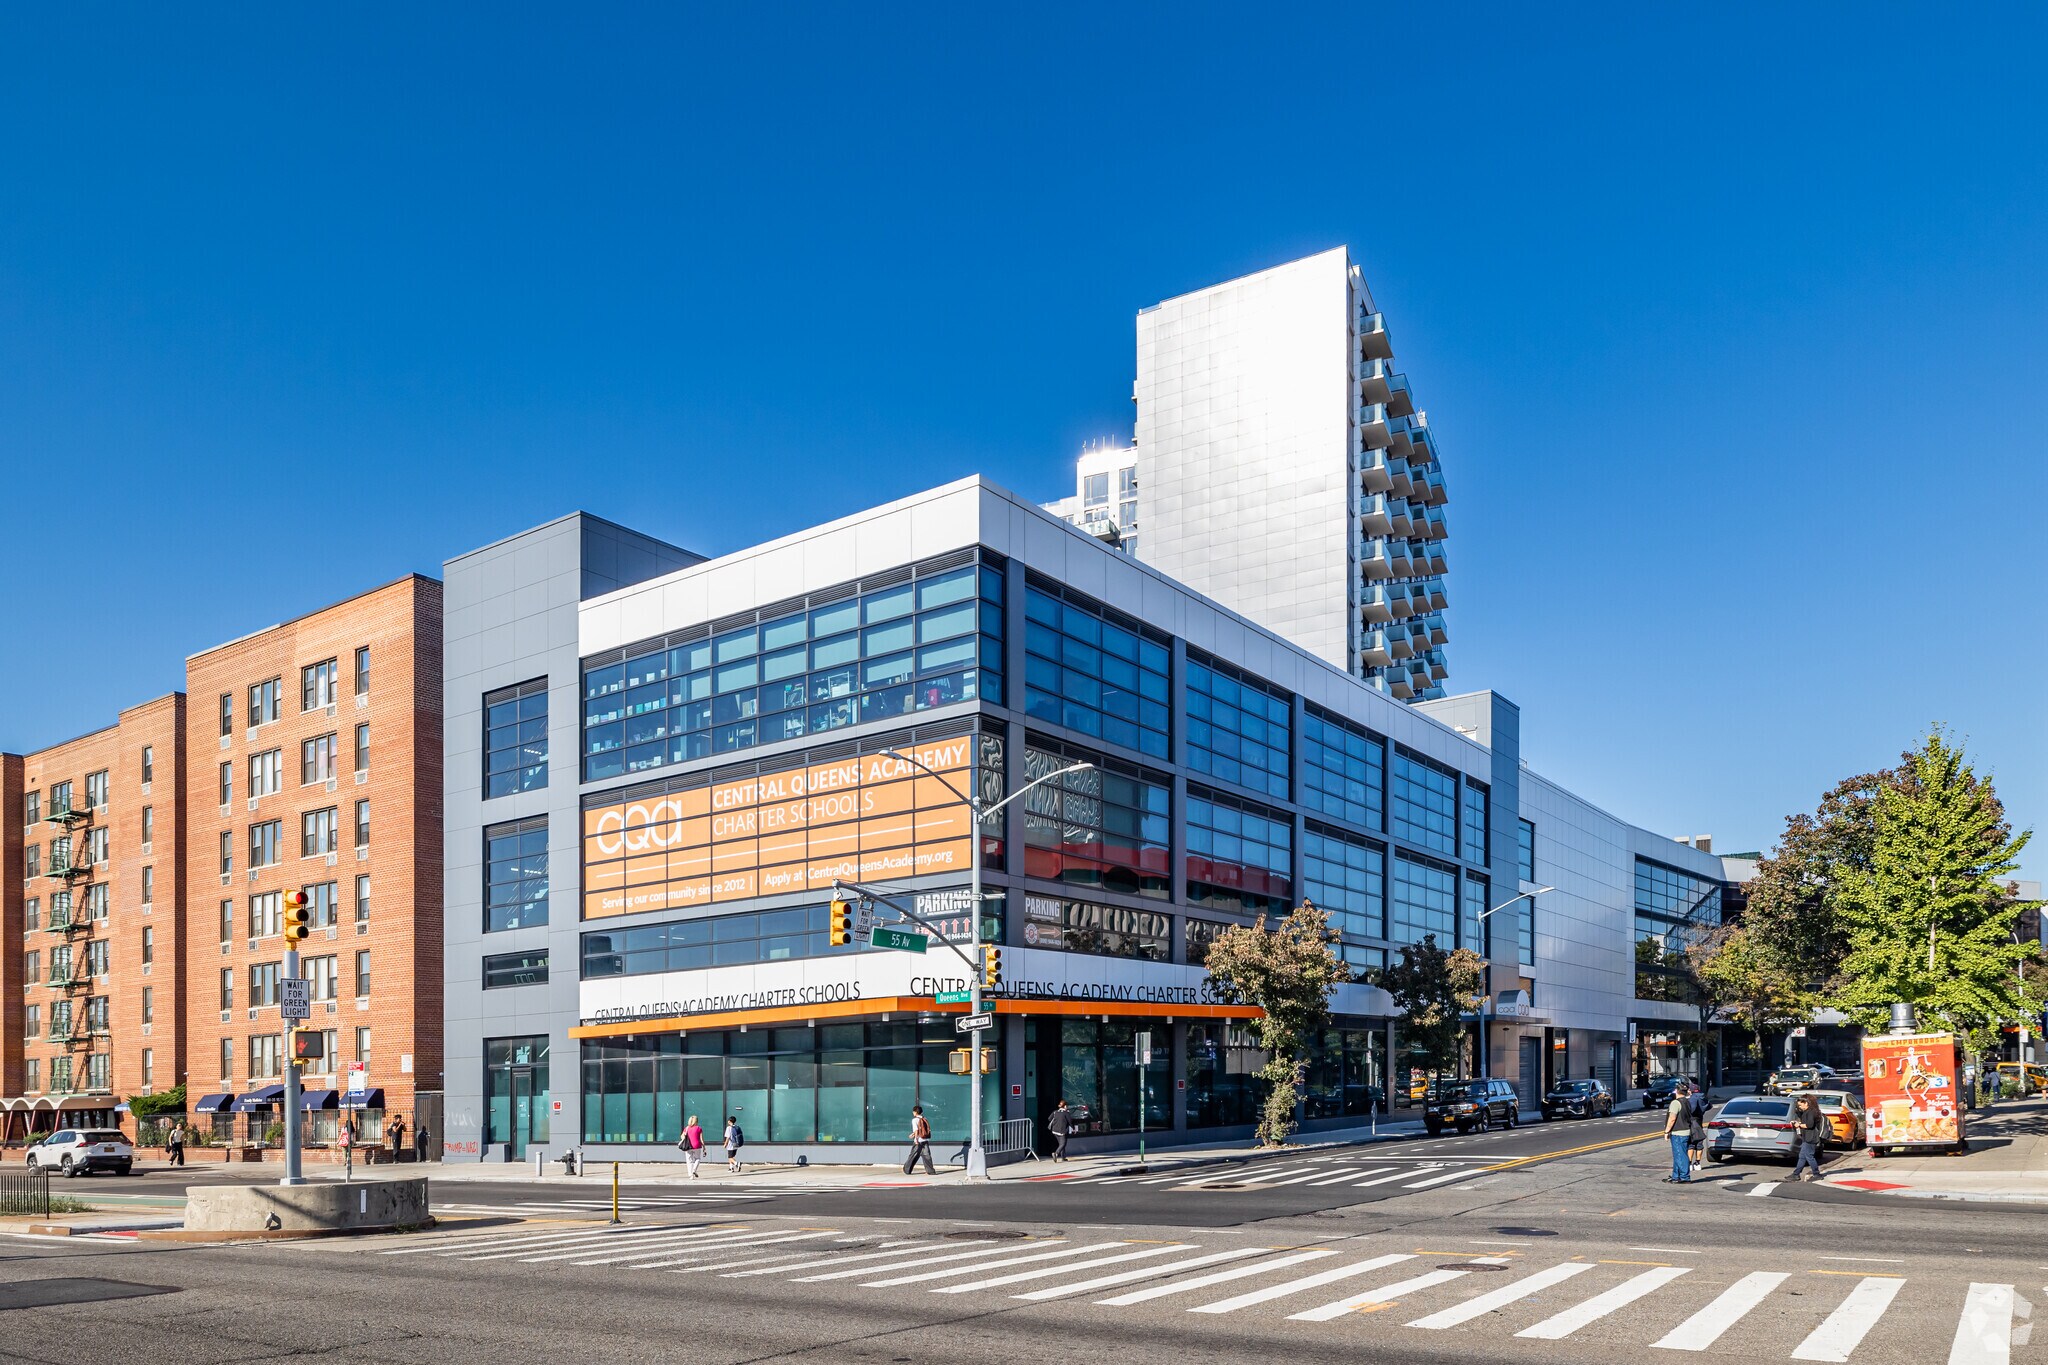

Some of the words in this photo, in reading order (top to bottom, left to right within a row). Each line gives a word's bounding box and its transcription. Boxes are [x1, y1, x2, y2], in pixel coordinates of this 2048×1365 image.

[713, 777, 786, 808] CENTRAL
[790, 764, 864, 793] QUEENS
[868, 743, 966, 781] ACADEMY
[713, 807, 786, 836] CHARTER
[790, 791, 875, 823] SCHOOLS
[764, 870, 791, 887] Apply
[793, 870, 803, 882] at
[807, 850, 953, 880] CentralQueensAcademy.org
[602, 897, 633, 909] Serving
[634, 895, 648, 904] our
[649, 886, 697, 903] community
[698, 882, 723, 894] since
[724, 878, 746, 892] 2012
[916, 889, 971, 914] PARKING
[1025, 897, 1061, 917] PARKING
[891, 933, 900, 946] 55
[902, 935, 910, 948] Av
[287, 981, 304, 990] WAIT
[992, 981, 1055, 999] QUEENS
[1062, 982, 1134, 1002] ACADEMY
[1137, 985, 1198, 1004] CHARTER
[288, 990, 303, 998] FOR
[939, 993, 959, 1002] Queens
[283, 998, 308, 1007] GREEN
[594, 1006, 635, 1025] CENTRAL
[640, 1001, 682, 1019] QUEENS
[683, 994, 740, 1013] ACADEMY
[740, 988, 796, 1009] CHARTER
[799, 981, 861, 1004] SCHOOLS
[983, 1001, 989, 1010] 55
[285, 1007, 306, 1016] LIGHT
[961, 1020, 972, 1028] ONE
[1934, 1077, 1943, 1087] 3
